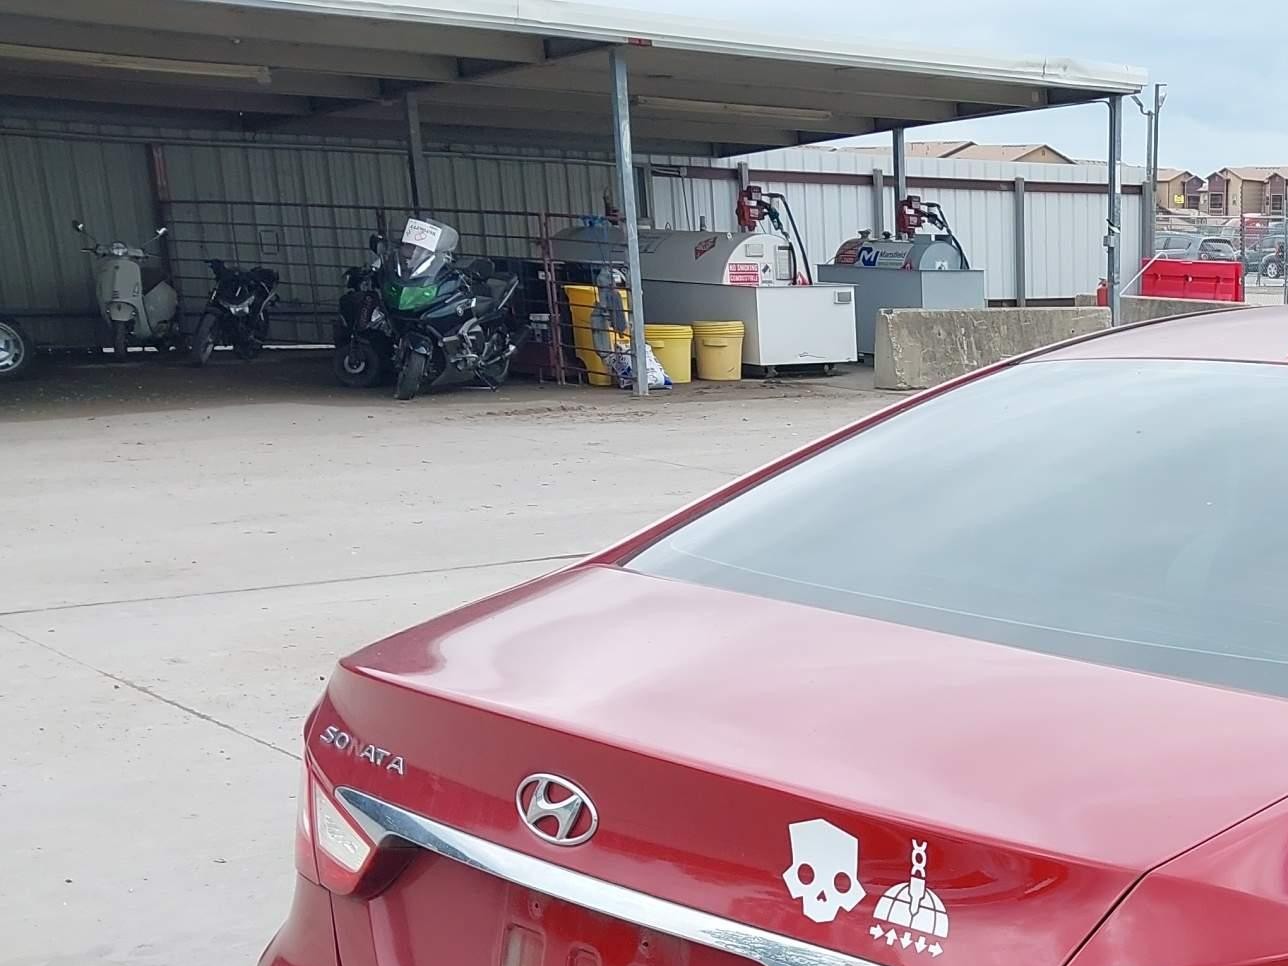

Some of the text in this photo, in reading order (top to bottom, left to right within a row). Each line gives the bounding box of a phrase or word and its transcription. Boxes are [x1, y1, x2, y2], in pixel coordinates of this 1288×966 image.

[729, 264, 758, 272] NO SMOKING
[319, 724, 405, 776] SONATA
